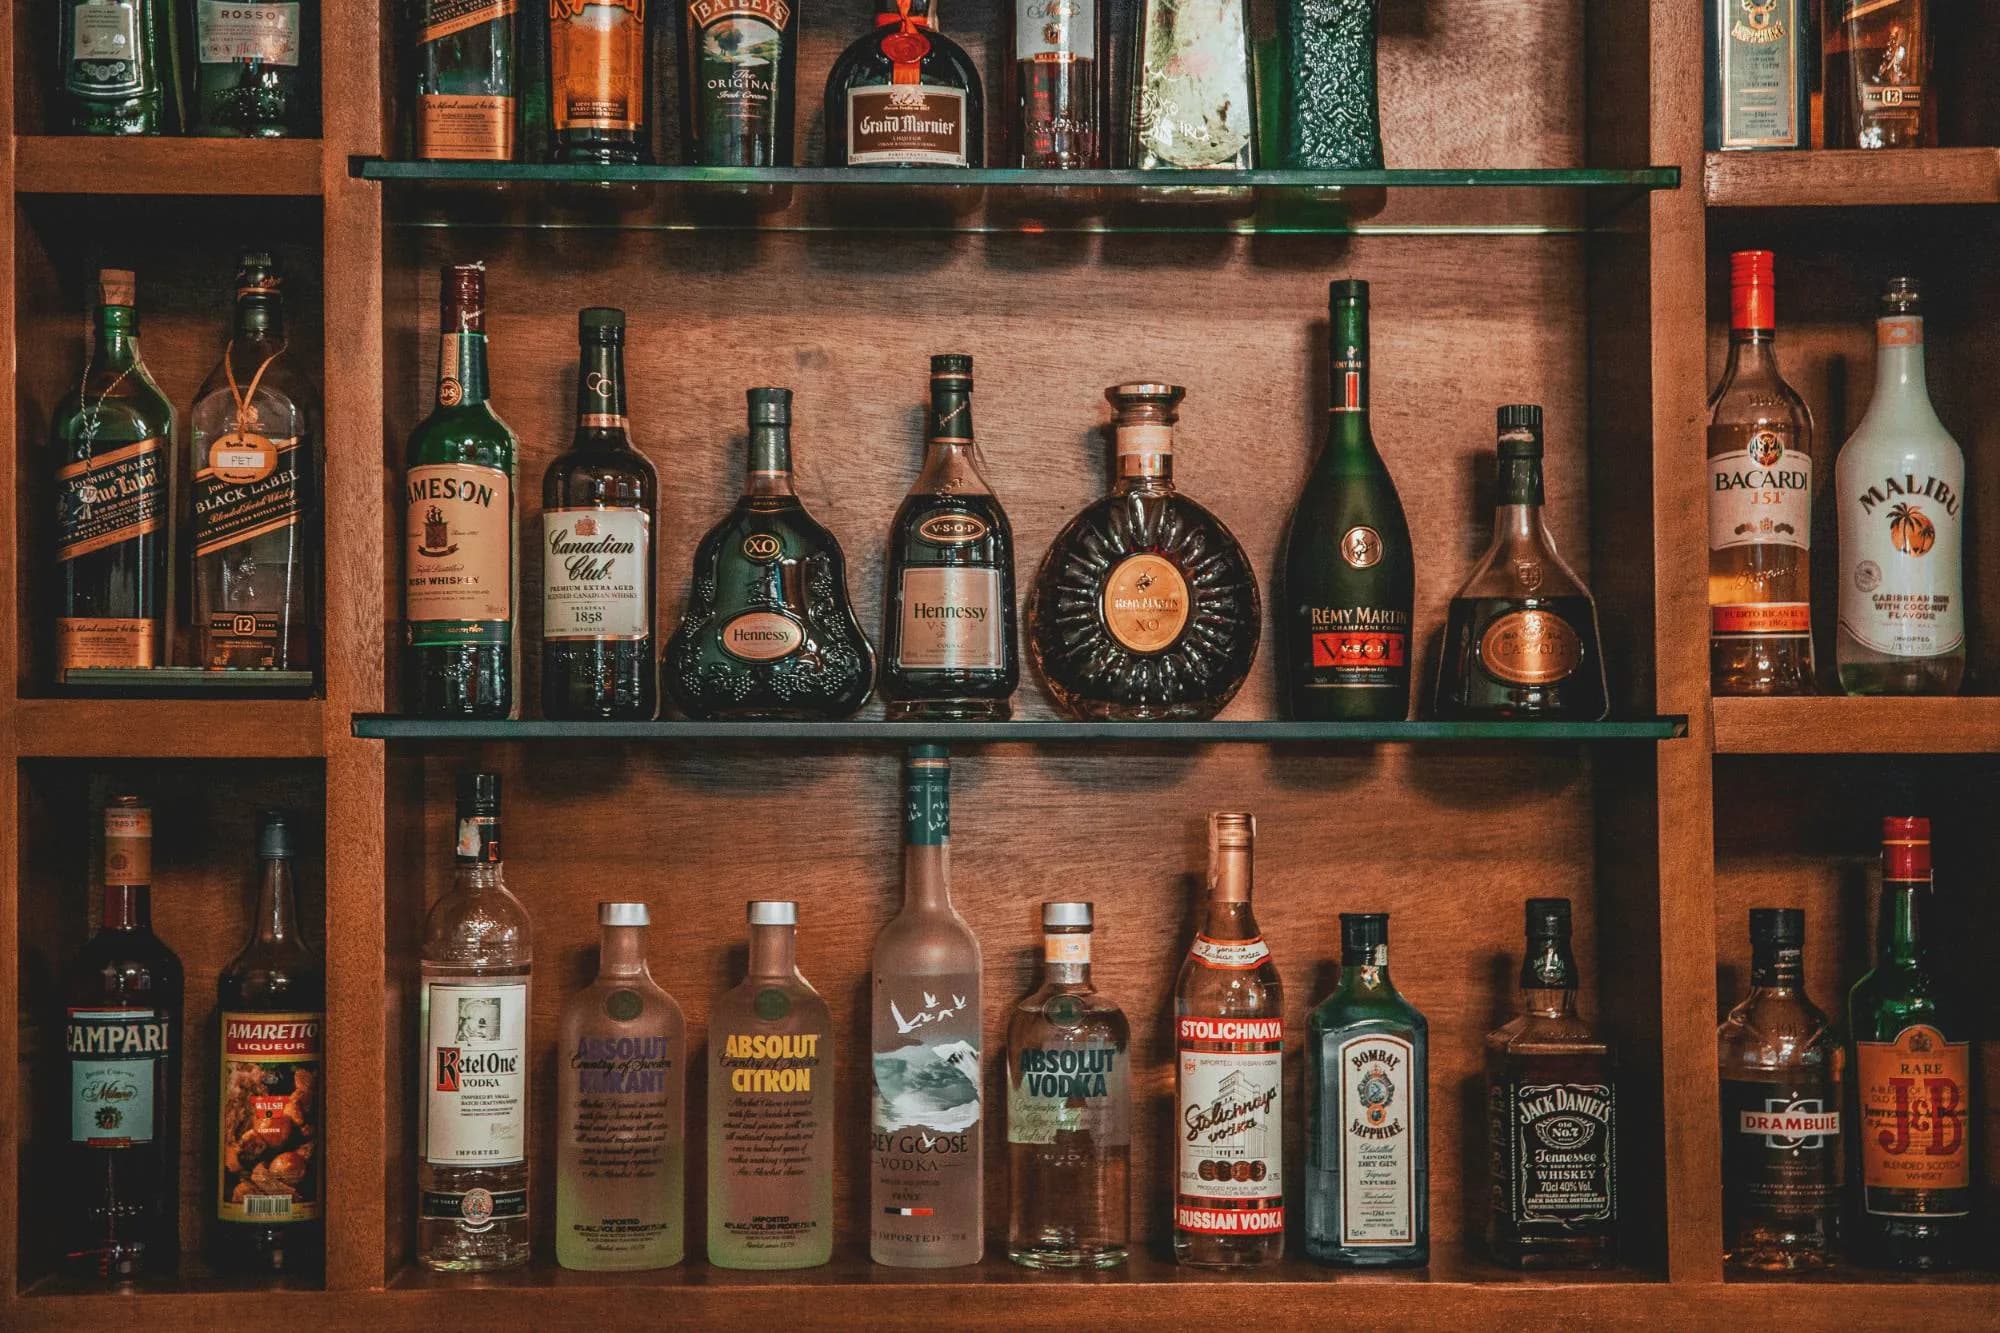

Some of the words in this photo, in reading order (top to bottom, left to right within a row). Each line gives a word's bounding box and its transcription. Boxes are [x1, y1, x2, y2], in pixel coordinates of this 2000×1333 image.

[221, 10, 276, 20] ROSSO
[732, 70, 756, 79] The
[708, 80, 776, 91] ORIGINAL
[860, 115, 900, 134] Grand
[901, 115, 955, 135] Marnier
[115, 468, 158, 497] Label
[1715, 471, 1808, 490] BACARDI
[195, 487, 247, 514] BLACK
[250, 469, 300, 495] LABEL
[407, 477, 493, 508] AMESON
[1752, 491, 1783, 504] 151
[1859, 474, 1960, 517] MALIBU
[549, 529, 634, 555] Canadian
[564, 555, 615, 581] Club
[408, 577, 426, 586] ISH
[429, 576, 480, 585] WHISKEY
[1872, 594, 1930, 602] CARIBBEAN
[1875, 602, 1900, 610] WITH
[1903, 603, 1948, 612] COCONUT
[575, 611, 602, 624] 1858
[914, 603, 988, 622] Hennessy
[1312, 606, 1353, 624] RÉMY
[1356, 607, 1407, 624] MARTIN
[238, 619, 251, 631] 12
[733, 629, 791, 643] Hennessy
[228, 1023, 318, 1041] AMARETTO
[1181, 1020, 1281, 1039] STOLICHNAYA
[237, 1042, 305, 1051] LIQUEUR
[725, 1034, 818, 1059] ABSOLUT
[1020, 1049, 1115, 1073] ABSOLUT
[1351, 1048, 1400, 1072] BOMBAY
[1901, 1063, 1943, 1074] RARE
[439, 1052, 484, 1089] Ketel
[487, 1052, 516, 1074] One
[462, 1078, 500, 1088] VODKA
[731, 1068, 810, 1092] CITRON
[1028, 1074, 1107, 1098] VODKA
[256, 1102, 284, 1110] WALSH
[1518, 1094, 1556, 1124] JACK
[1349, 1119, 1405, 1140] SAPPHIRE
[1744, 1115, 1838, 1131] DRAMBUIE
[1552, 1127, 1579, 1138] No.7
[874, 1133, 895, 1153] EY
[900, 1134, 968, 1154] GOOSE
[881, 1157, 939, 1172] VODKA
[1535, 1149, 1597, 1163] Tennessee
[1536, 1170, 1597, 1181] WHISKEY
[1540, 1181, 1559, 1192] 70cl
[1559, 1181, 1578, 1192] 40%
[1180, 1210, 1238, 1229] RUSSIAN
[1240, 1211, 1282, 1230] VODKA
